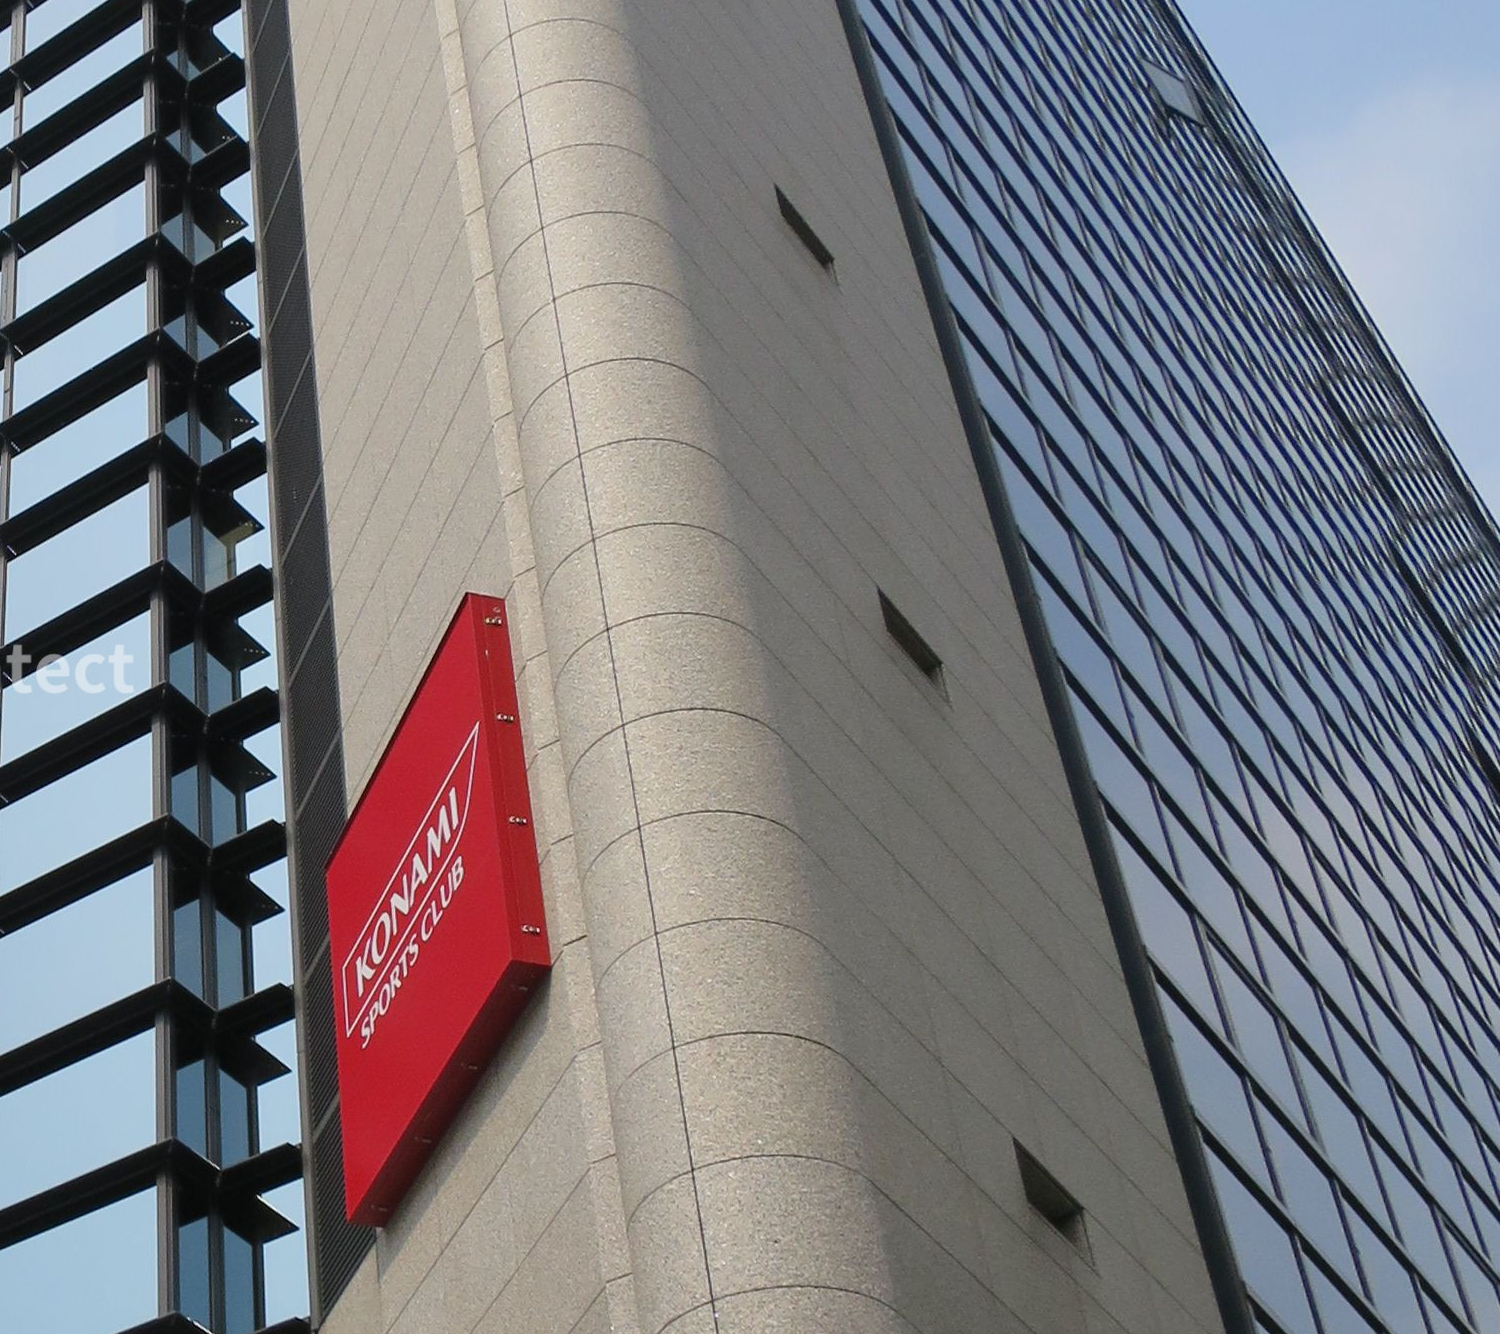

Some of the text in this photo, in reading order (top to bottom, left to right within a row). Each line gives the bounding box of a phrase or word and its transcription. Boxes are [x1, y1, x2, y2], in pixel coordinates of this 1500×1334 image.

[357, 786, 460, 997] KONAMI
[361, 856, 464, 1049] SPORTS CLUB
